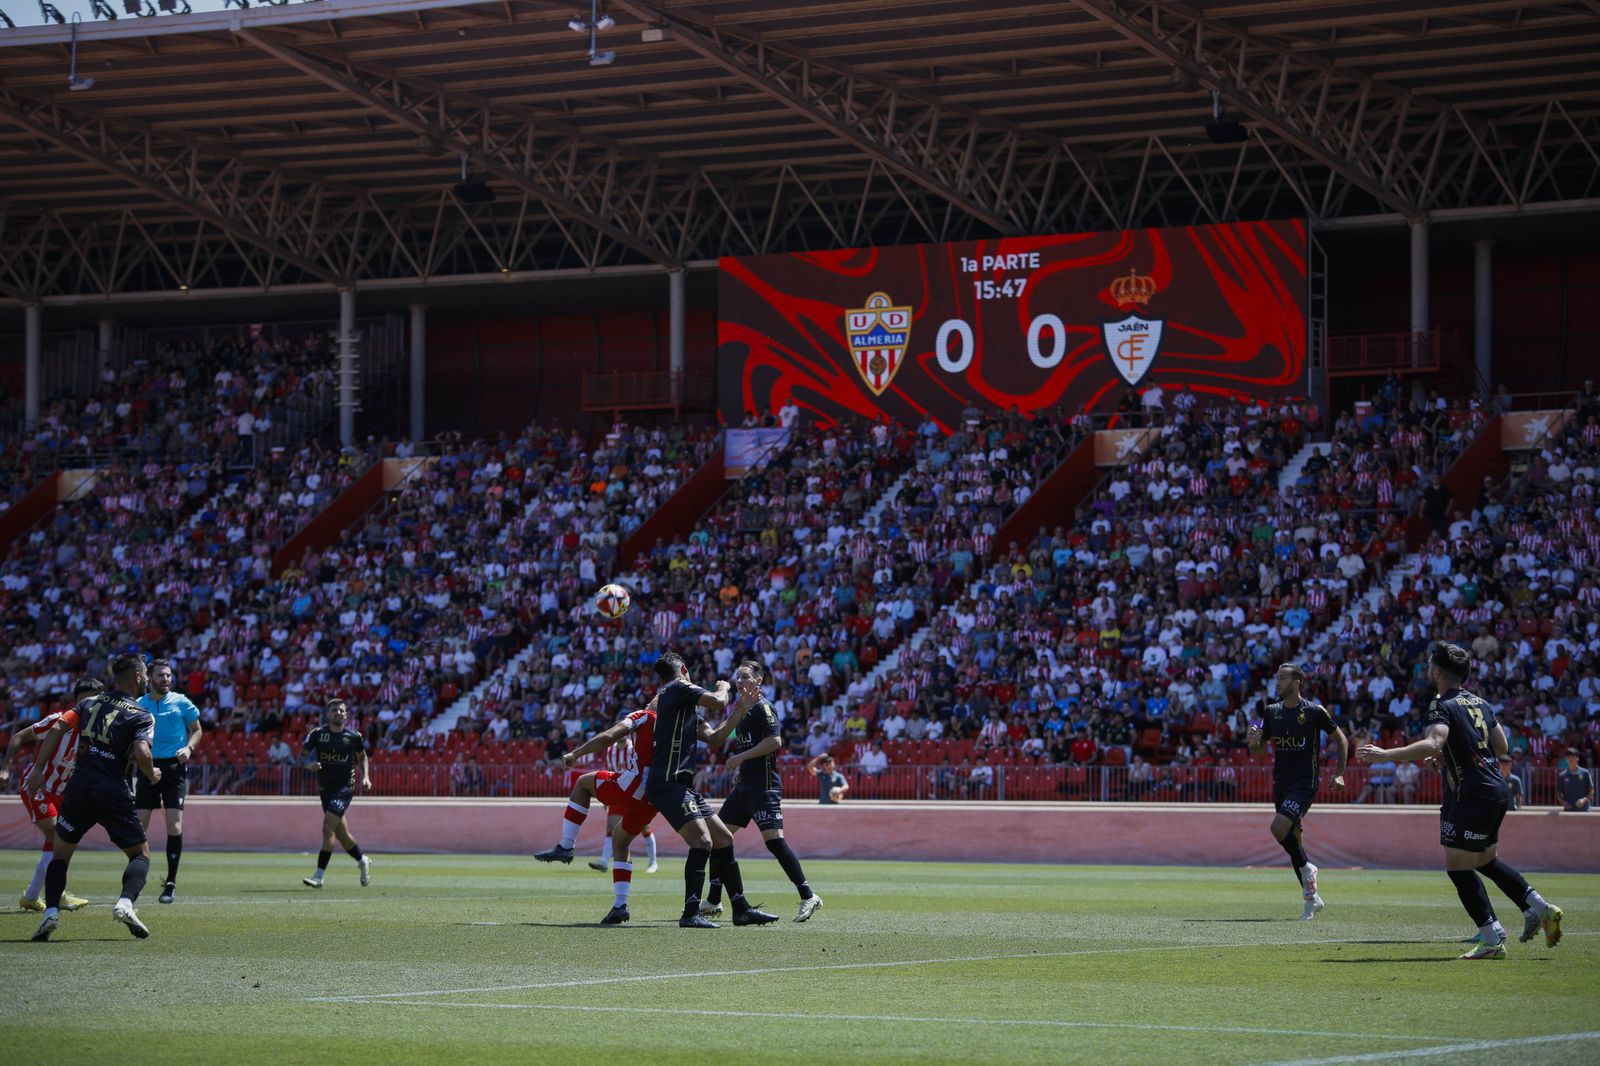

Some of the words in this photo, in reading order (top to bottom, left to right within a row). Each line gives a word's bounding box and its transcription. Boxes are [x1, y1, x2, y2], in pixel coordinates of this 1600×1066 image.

[960, 257, 978, 272] 1a
[982, 252, 1040, 271] PARTE
[974, 278, 1027, 300] 15:47
[854, 315, 866, 328] U
[890, 313, 903, 326] D
[1118, 322, 1148, 332] JAÉN
[853, 334, 904, 346] ALMERIA
[935, 318, 974, 373] 0
[1027, 313, 1066, 369] 0
[81, 702, 120, 745] 11
[1467, 706, 1489, 750] 3
[319, 733, 330, 743] 10
[681, 800, 699, 817] 16
